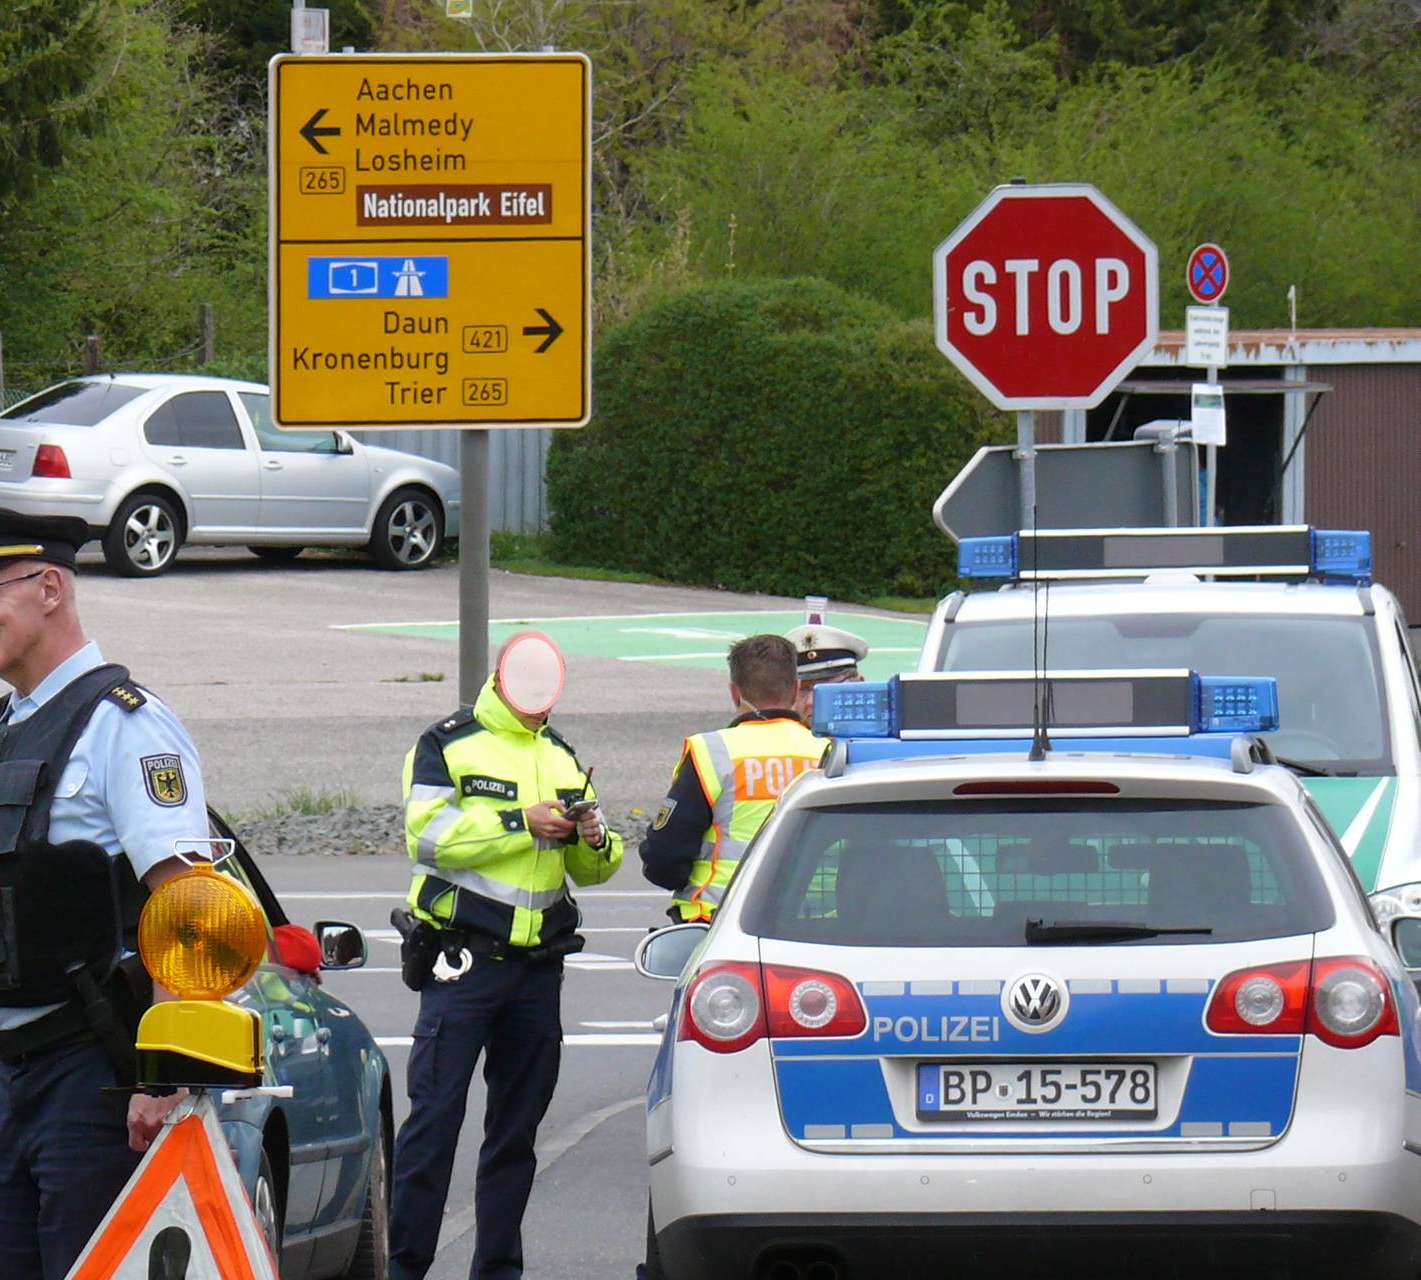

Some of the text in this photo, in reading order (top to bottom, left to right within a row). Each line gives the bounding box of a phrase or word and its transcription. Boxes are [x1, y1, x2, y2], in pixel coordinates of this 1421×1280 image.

[356, 78, 453, 101] Aachen
[356, 113, 473, 141] Malmedy
[356, 149, 466, 172] Losheim
[305, 172, 340, 190] 265
[363, 191, 545, 223] Nationalpark Eifel
[349, 268, 358, 288] 1
[962, 258, 1130, 336] STOP
[384, 311, 448, 334] Daun
[469, 331, 502, 349] 421
[293, 347, 448, 375] Kronenburg
[386, 382, 447, 405] Trier
[468, 383, 502, 401] 265
[471, 779, 505, 794] POLIZEI
[873, 1016, 999, 1042] POLIZEI
[943, 1070, 993, 1105] BP
[1016, 1069, 1151, 1105] 15-578
